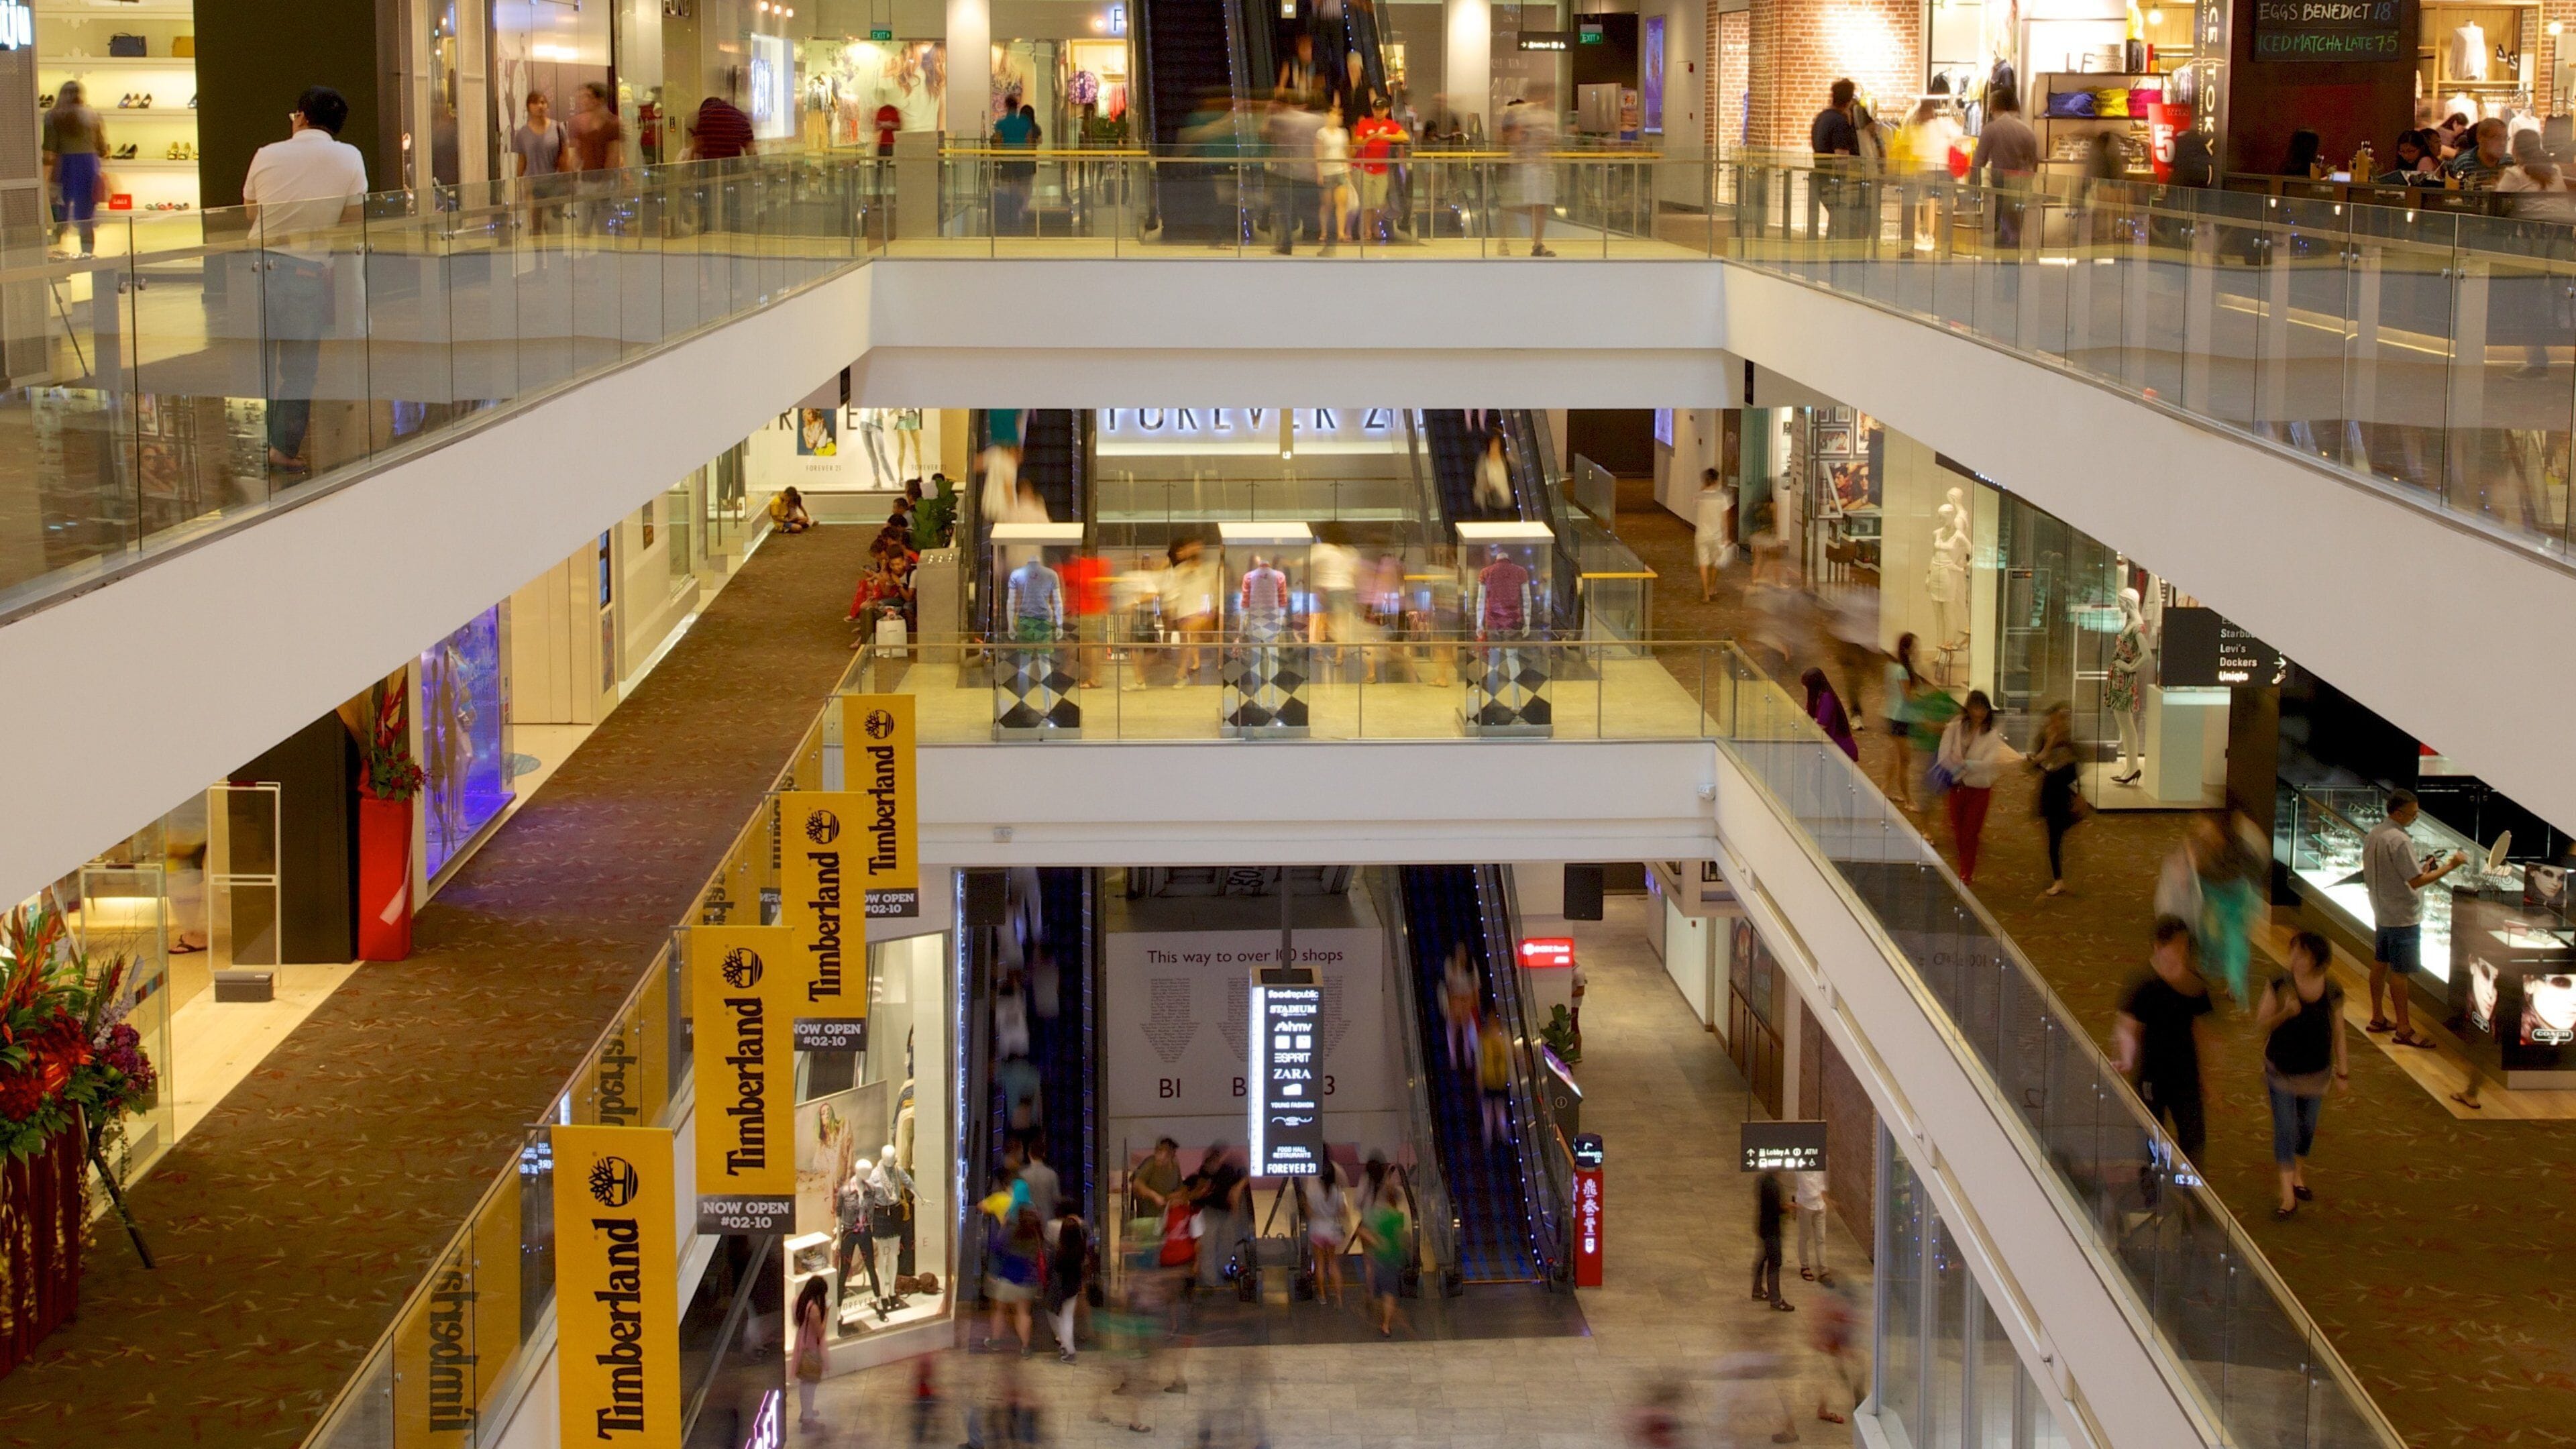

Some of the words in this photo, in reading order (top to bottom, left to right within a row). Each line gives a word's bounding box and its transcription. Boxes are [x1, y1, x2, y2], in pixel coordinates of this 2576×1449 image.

[2259, 3, 2298, 20] EGGS
[2302, 3, 2371, 21] BENEDICT
[2258, 36, 2292, 52] ICED
[2294, 34, 2343, 53] MATCHA
[2220, 644, 2247, 653] Levi's
[2219, 657, 2258, 667] Dockers
[2218, 671, 2249, 682] Uniqlo
[866, 745, 897, 875] Timberland
[882, 893, 914, 904] OPEN
[807, 852, 841, 1002] Timberland
[1147, 950, 1178, 963] This
[1183, 953, 1212, 967] way
[1216, 952, 1232, 963] to
[1237, 953, 1271, 962] over
[1301, 948, 1344, 965] shops
[1268, 989, 1319, 1000] foodrepublic
[1269, 1005, 1317, 1014] STADIUM
[824, 1023, 861, 1035] OPEN
[1288, 1021, 1312, 1032] hmv
[2536, 1030, 2569, 1038] COACH
[803, 1036, 847, 1047] #02-10
[1274, 1053, 1311, 1063] ESPRIT
[1273, 1069, 1312, 1079] ZARA
[724, 997, 765, 1176] Timberland
[1766, 1148, 1784, 1157] Lobby
[1267, 1163, 1306, 1174] FOREVER
[1307, 1163, 1316, 1173] 21
[703, 1201, 743, 1215] NOW
[745, 1201, 790, 1215] OPEN
[720, 1216, 772, 1229] #02-10
[843, 1297, 873, 1311] OREVER
[591, 1218, 645, 1441] Timberland
